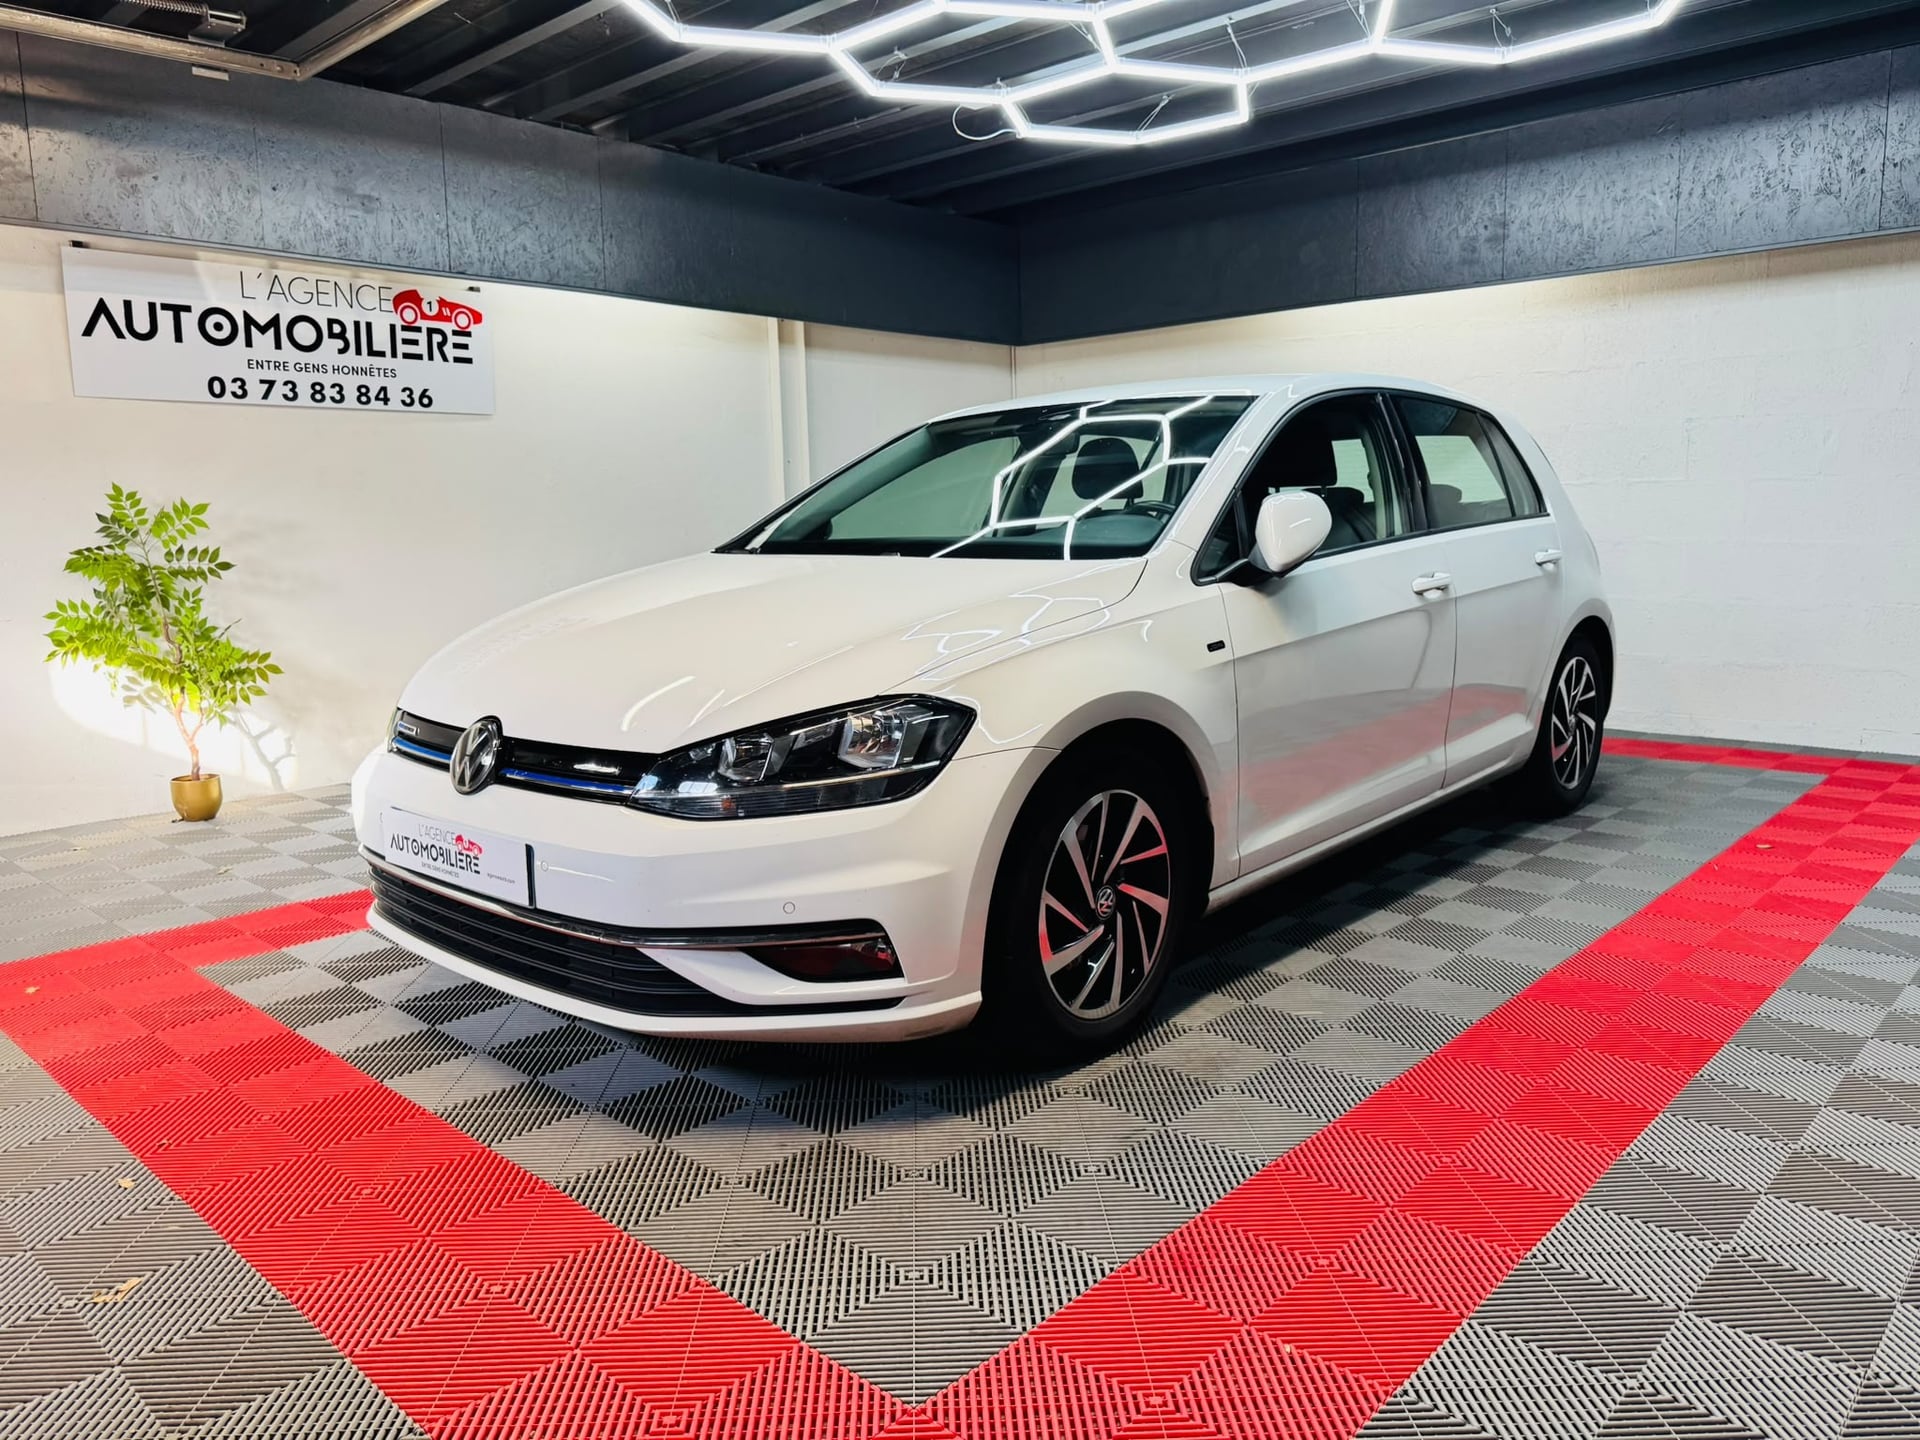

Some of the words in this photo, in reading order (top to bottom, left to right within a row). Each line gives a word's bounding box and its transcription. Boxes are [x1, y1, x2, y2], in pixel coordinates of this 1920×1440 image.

[240, 270, 393, 313] L'AGENCE
[247, 359, 290, 372] ENTRE
[294, 363, 329, 375] GENS
[332, 364, 397, 378] HONNÊTES
[207, 376, 249, 400] 03
[258, 379, 299, 403] 73
[310, 382, 346, 404] 83
[356, 385, 391, 406] 84
[400, 387, 434, 408] 36
